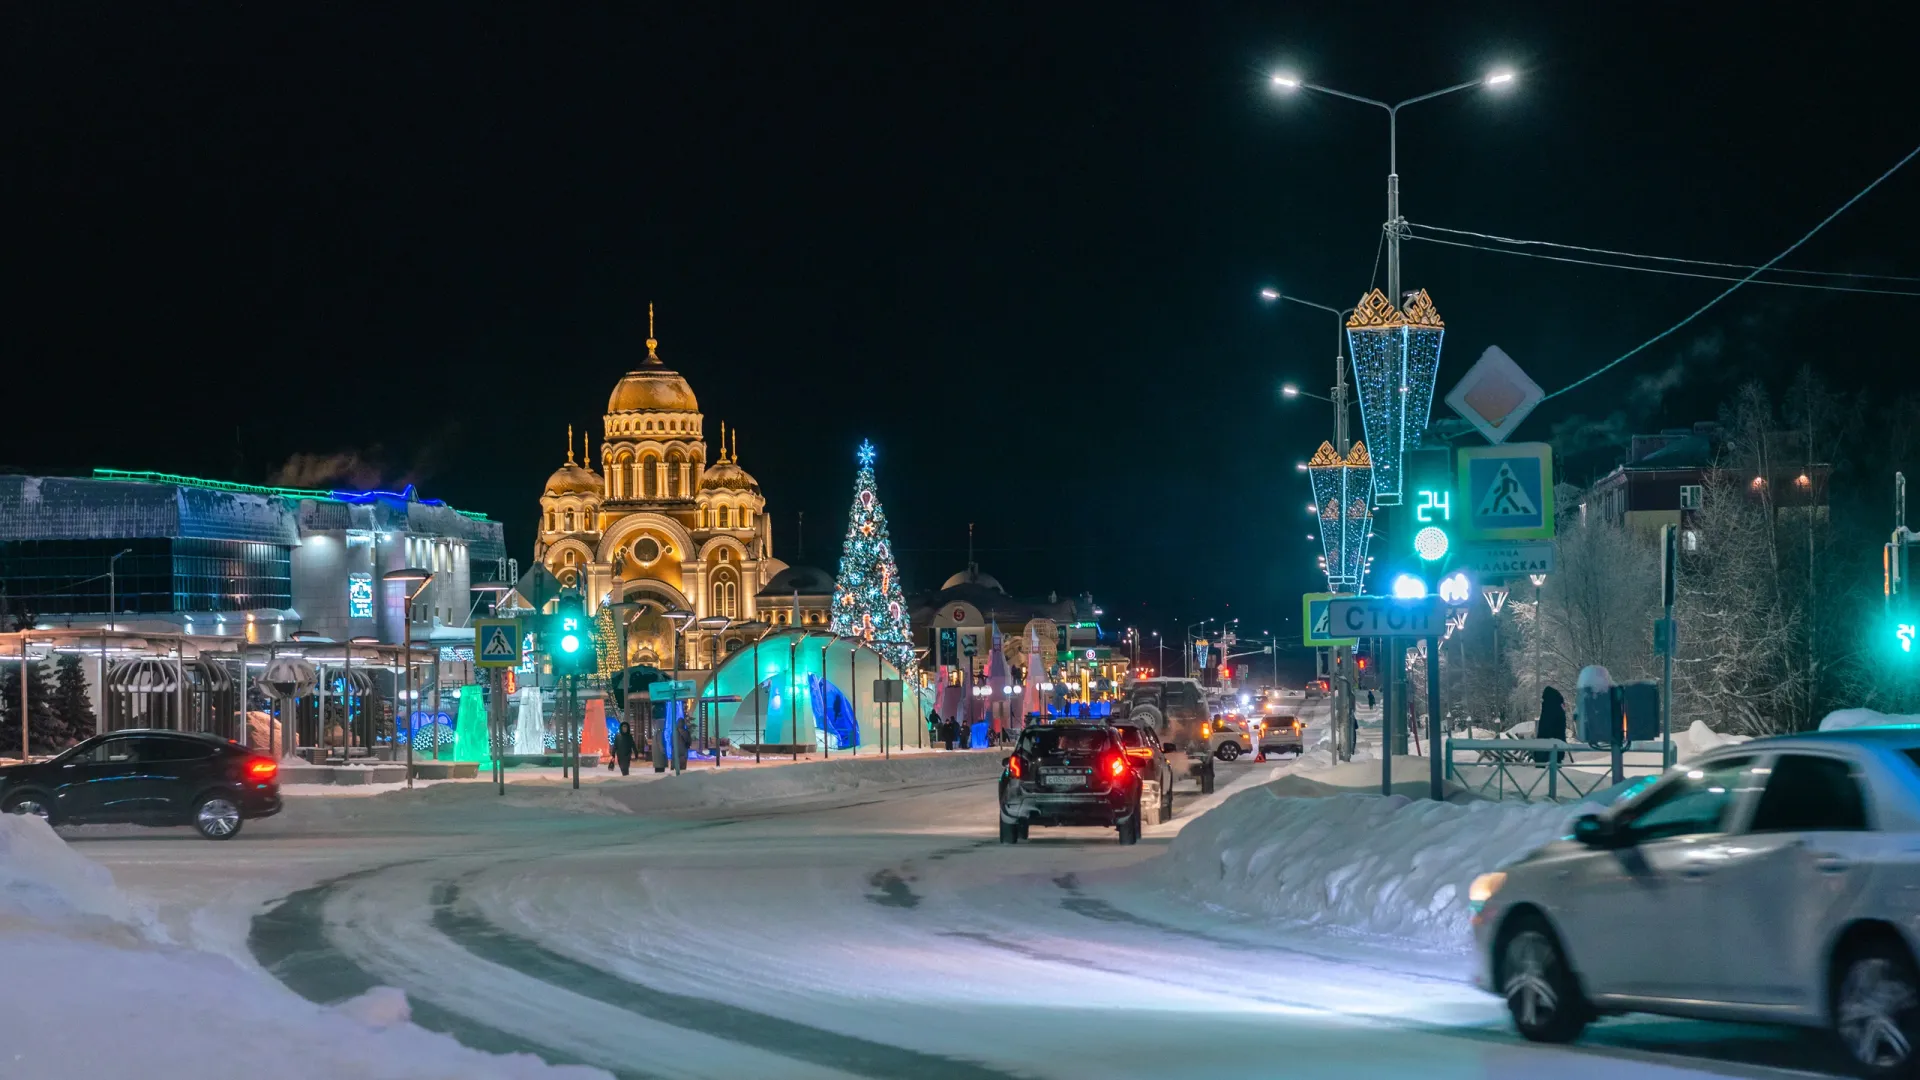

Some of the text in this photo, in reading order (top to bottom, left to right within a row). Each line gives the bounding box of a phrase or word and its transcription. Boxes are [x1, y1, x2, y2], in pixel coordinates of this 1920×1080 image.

[1417, 490, 1450, 523] 24
[563, 617, 578, 631] 24
[1345, 605, 1429, 631] СТОП
